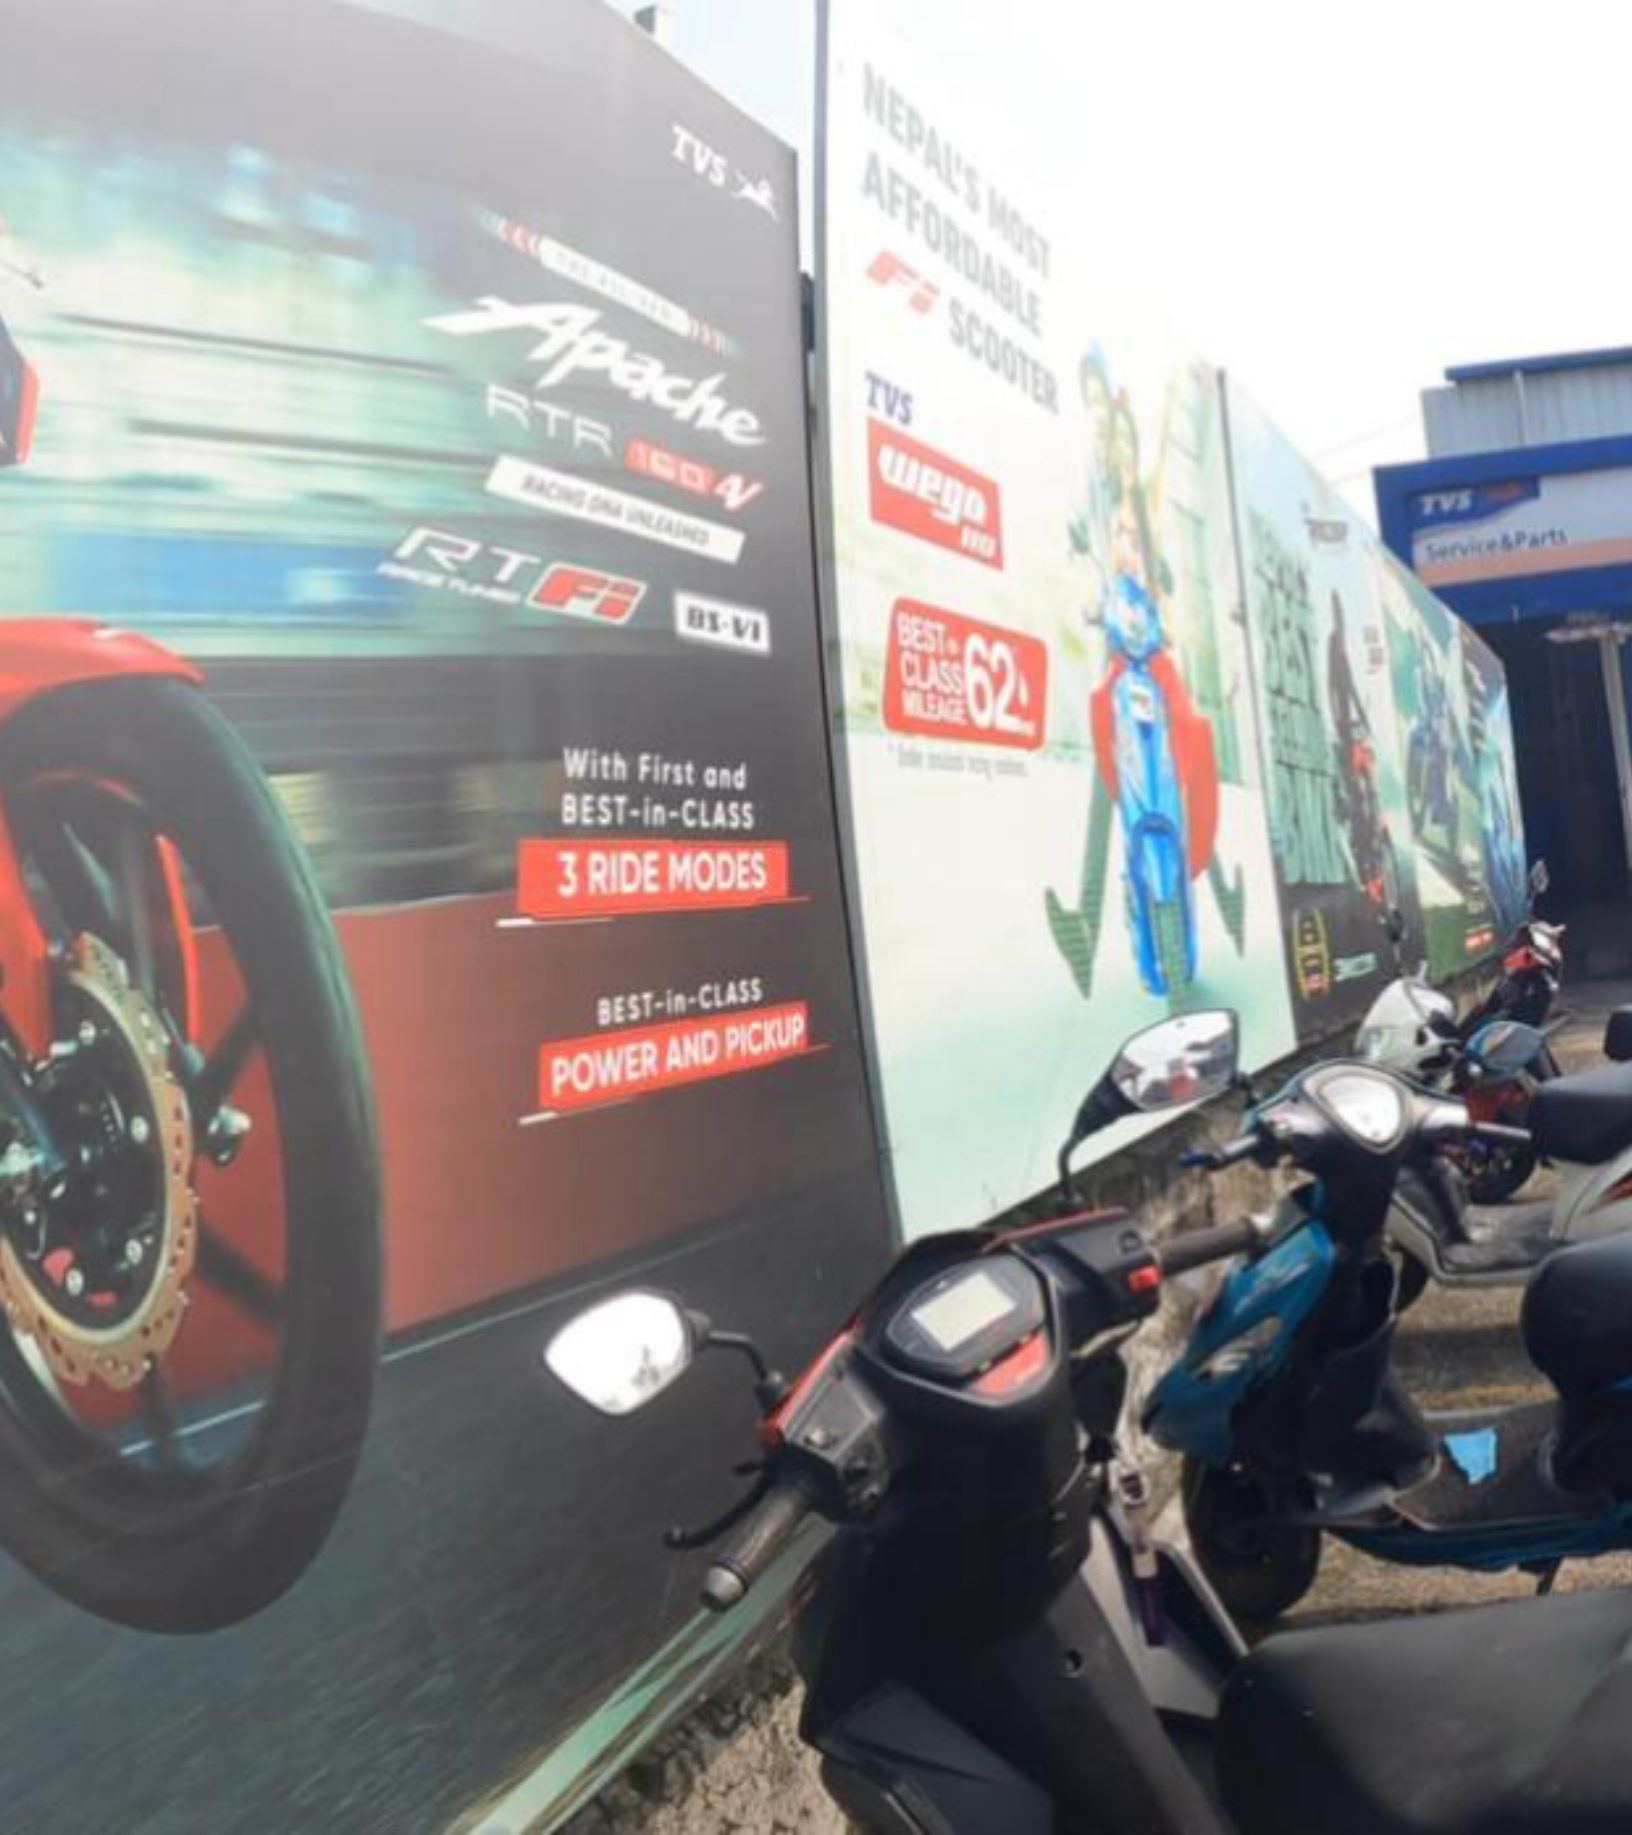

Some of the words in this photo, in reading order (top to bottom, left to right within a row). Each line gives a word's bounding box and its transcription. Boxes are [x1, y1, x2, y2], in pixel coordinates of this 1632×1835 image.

[670, 125, 728, 186] TVS
[863, 61, 982, 214] NEPAL'S
[986, 185, 1052, 280] MOST
[862, 151, 1042, 338] AFFORDABLE
[420, 296, 766, 445] Apache
[948, 296, 1061, 417] SCOOTER
[486, 384, 612, 457] RTR
[865, 369, 914, 426] TVS
[1422, 489, 1472, 514] TVS
[686, 606, 761, 642] BS-VI
[563, 748, 628, 783] With
[638, 753, 696, 788] First
[703, 763, 748, 791] and
[560, 793, 755, 831] BEST-in-CLASS
[556, 853, 579, 897] 3
[586, 851, 660, 894] RIDE
[668, 852, 768, 892] MODES
[597, 977, 764, 1026] BEST-in-CLASS
[551, 1045, 658, 1096] POWER
[665, 1033, 719, 1070] AND
[725, 1014, 807, 1061] PICKUP
